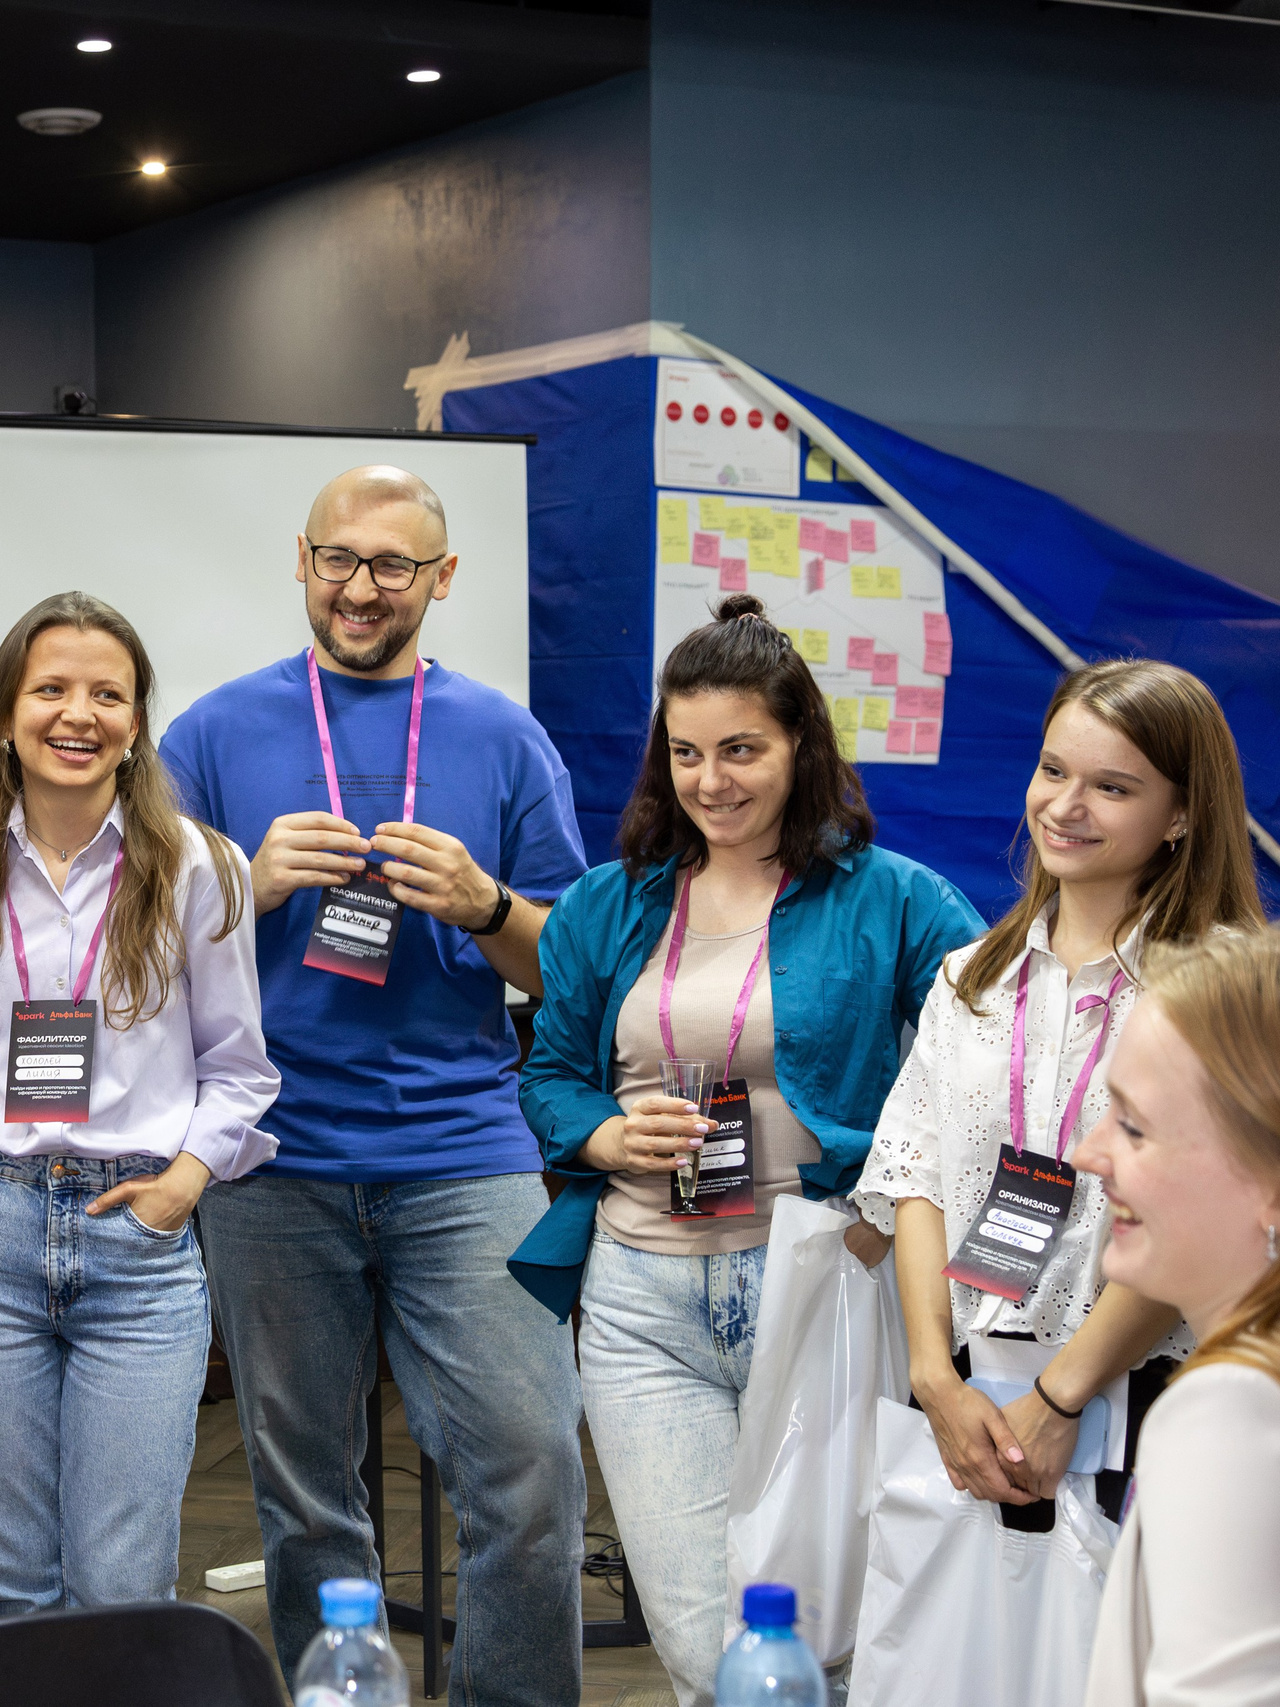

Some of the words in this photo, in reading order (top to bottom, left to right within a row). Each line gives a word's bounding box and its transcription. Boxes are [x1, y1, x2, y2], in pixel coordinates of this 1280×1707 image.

[49, 1011, 73, 1020] Альфа
[26, 1069, 60, 1078] ЛИЛИЯ
[728, 1093, 747, 1102] Банк
[1004, 1161, 1030, 1176] spark
[1032, 1168, 1056, 1182] Альфа
[1055, 1175, 1074, 1188] Банк
[998, 1190, 1060, 1214] ОРГАНИЗАТОР
